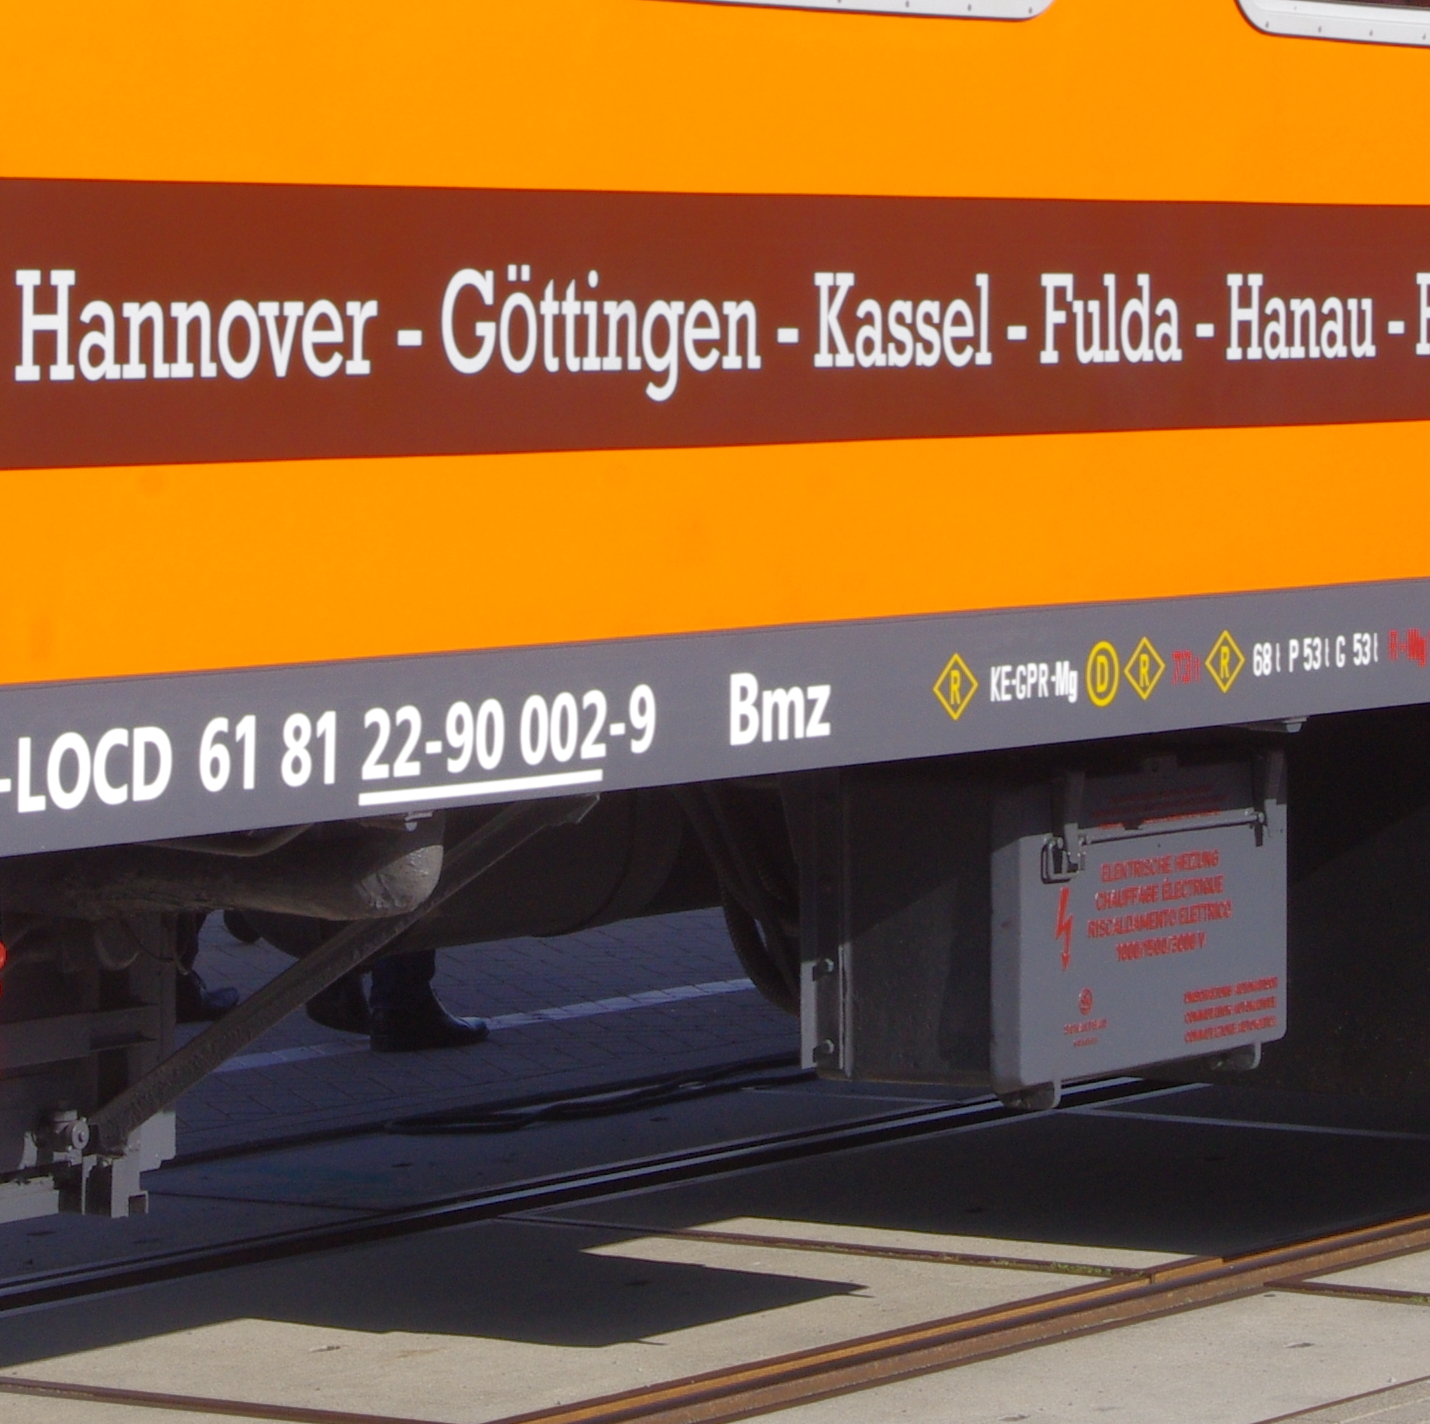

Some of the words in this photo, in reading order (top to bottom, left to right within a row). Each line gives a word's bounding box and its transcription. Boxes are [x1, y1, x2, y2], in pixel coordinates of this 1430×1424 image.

[15, 269, 378, 382] Hannover
[442, 264, 762, 402] Göttingen
[814, 272, 992, 368] Kassel
[1040, 273, 1183, 364] Fulda
[1226, 273, 1376, 361] Hanau
[1288, 638, 1300, 673] P
[1335, 634, 1346, 668] G
[198, 715, 257, 793] 61
[280, 710, 337, 788] 81
[361, 698, 506, 781] 22-90
[519, 683, 657, 766] 002-9
[729, 672, 831, 746] Bmz
